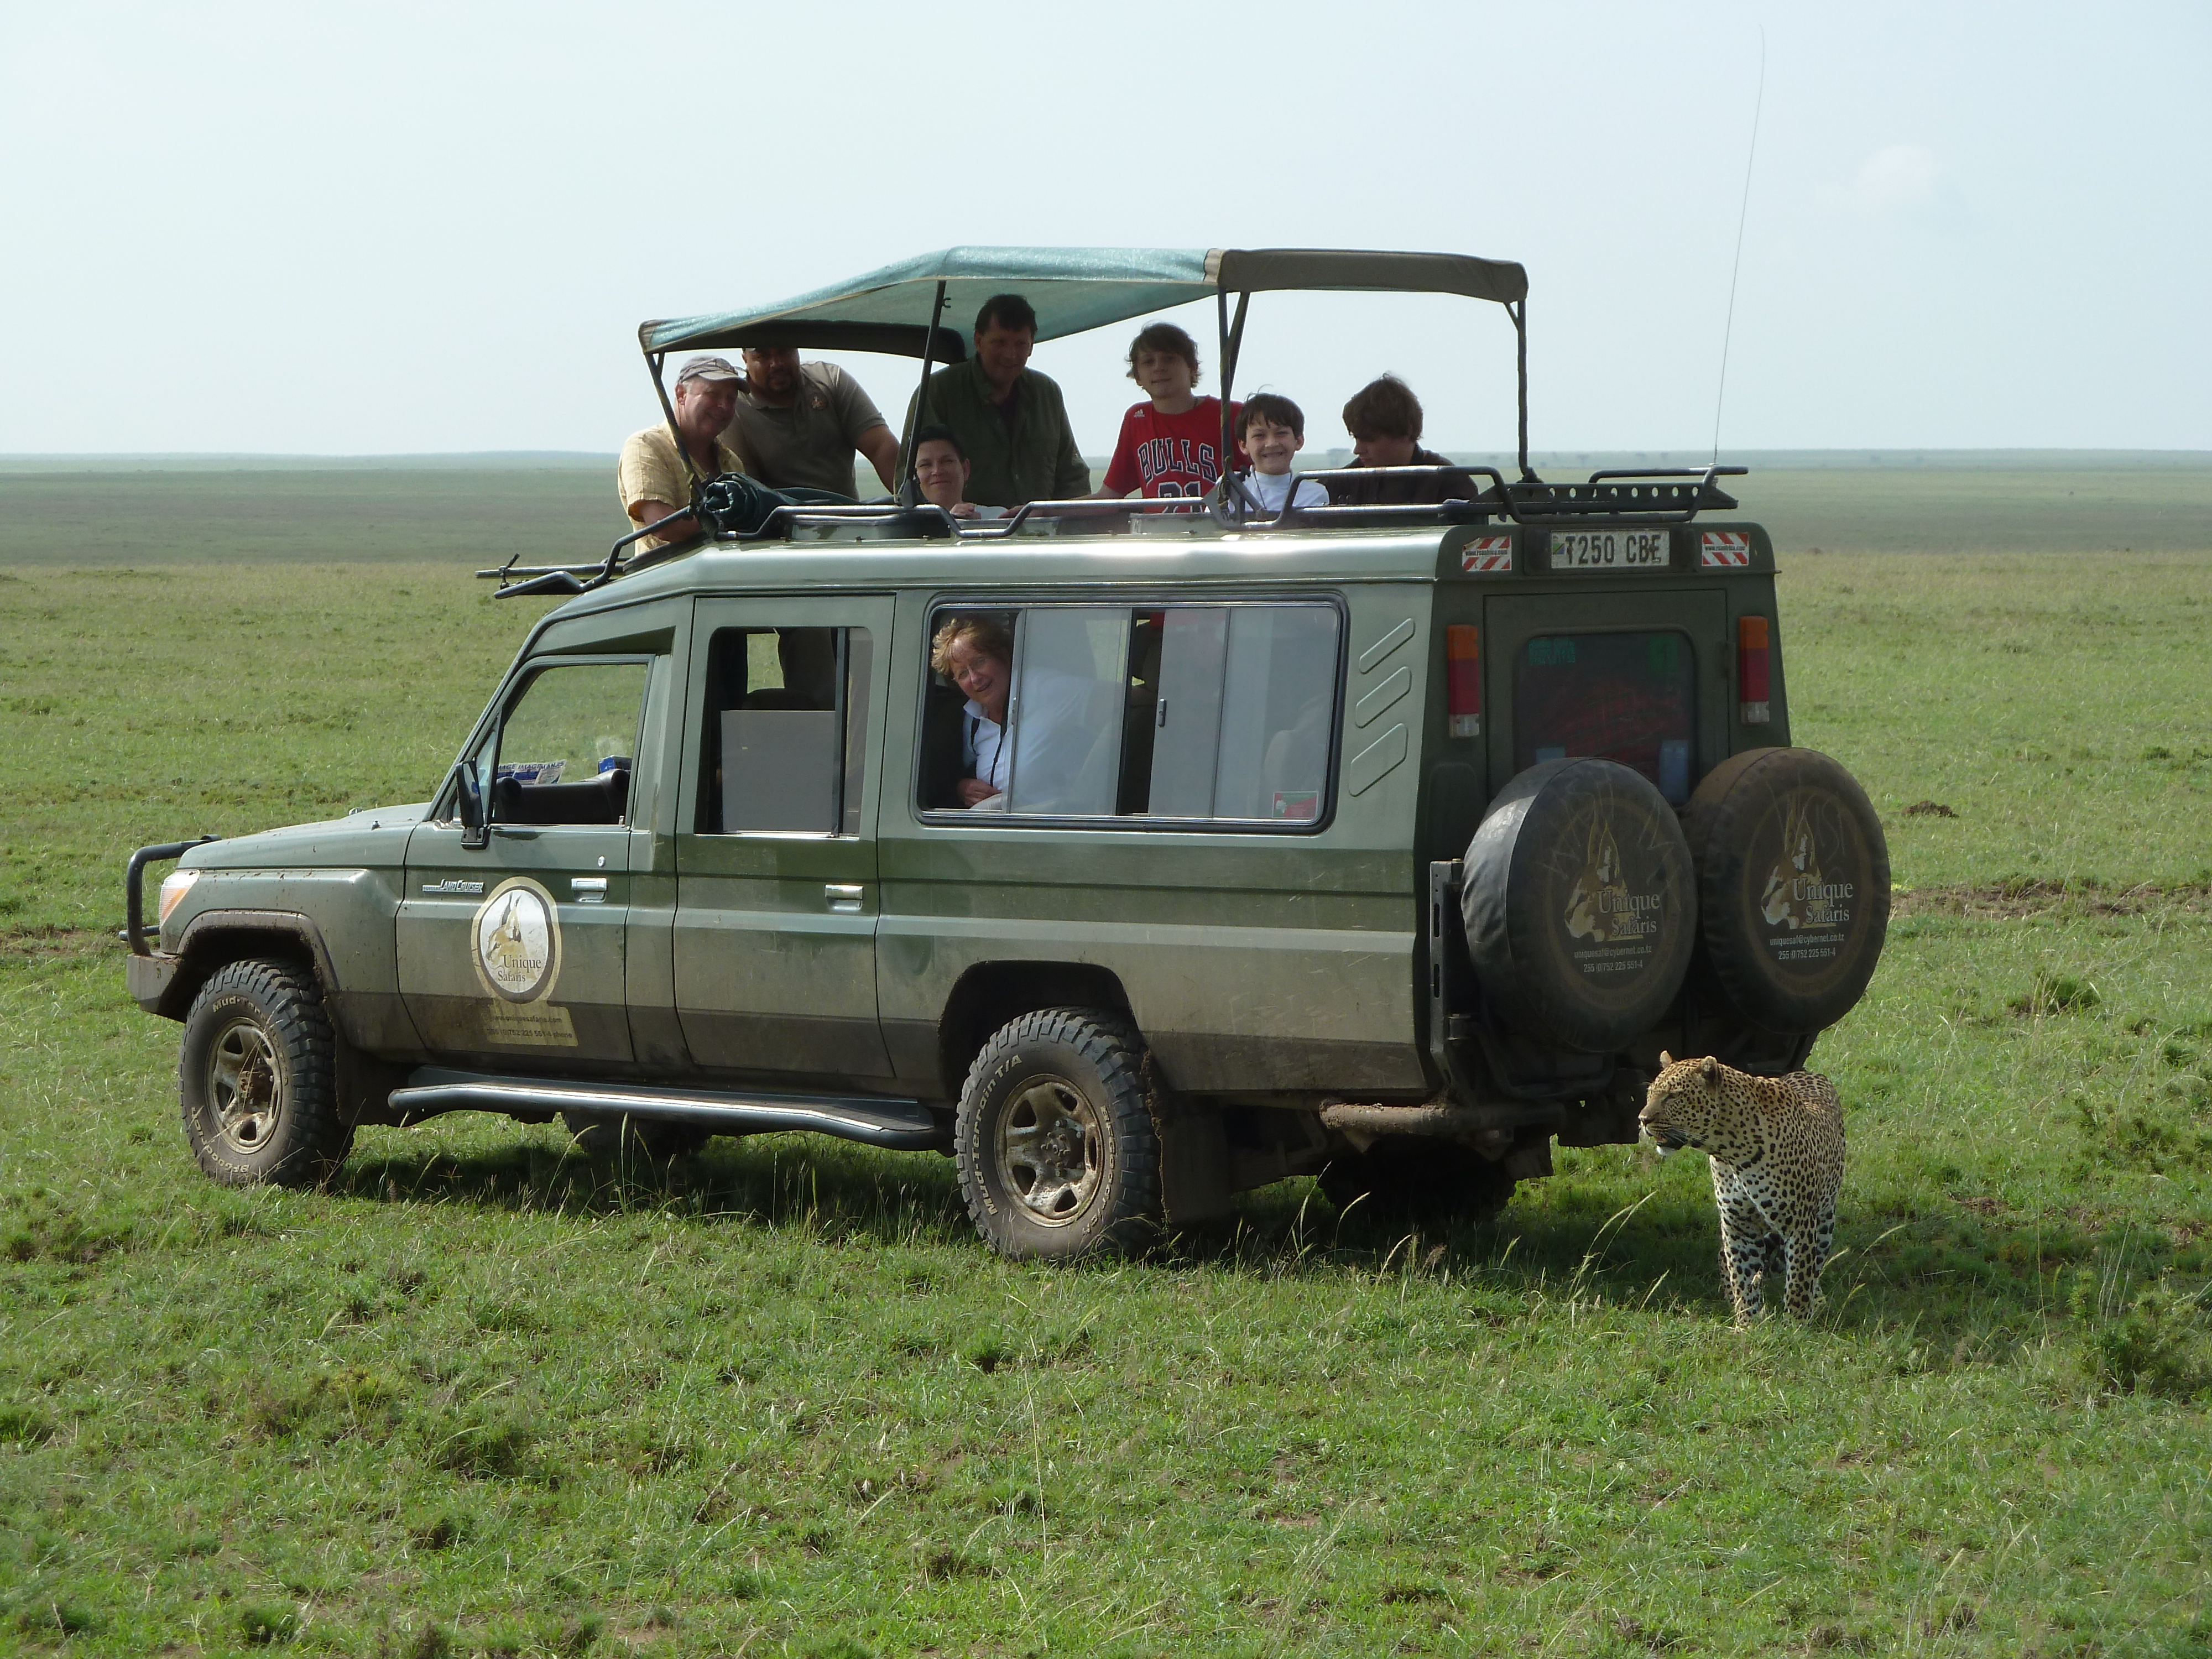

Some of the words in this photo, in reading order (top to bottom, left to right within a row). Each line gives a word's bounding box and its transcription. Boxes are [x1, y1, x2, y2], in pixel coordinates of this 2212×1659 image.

[1138, 437, 1217, 484] BULLS
[1566, 535, 1615, 564] T250
[1626, 534, 1661, 563] CBE
[1597, 889, 1659, 919] Unique
[1792, 878, 1853, 907] Unique
[1611, 915, 1657, 936] Safaris
[1806, 904, 1849, 924] Safaris
[503, 954, 541, 973] Unique
[1778, 951, 1790, 960] 255
[1808, 948, 1819, 958] 225
[498, 970, 526, 982] Safaris
[1584, 964, 1595, 973] 255
[972, 1078, 998, 1215] Mud-Terrain
[995, 1054, 1022, 1078] T/A
[1083, 1105, 1115, 1235] BFGoodrich
